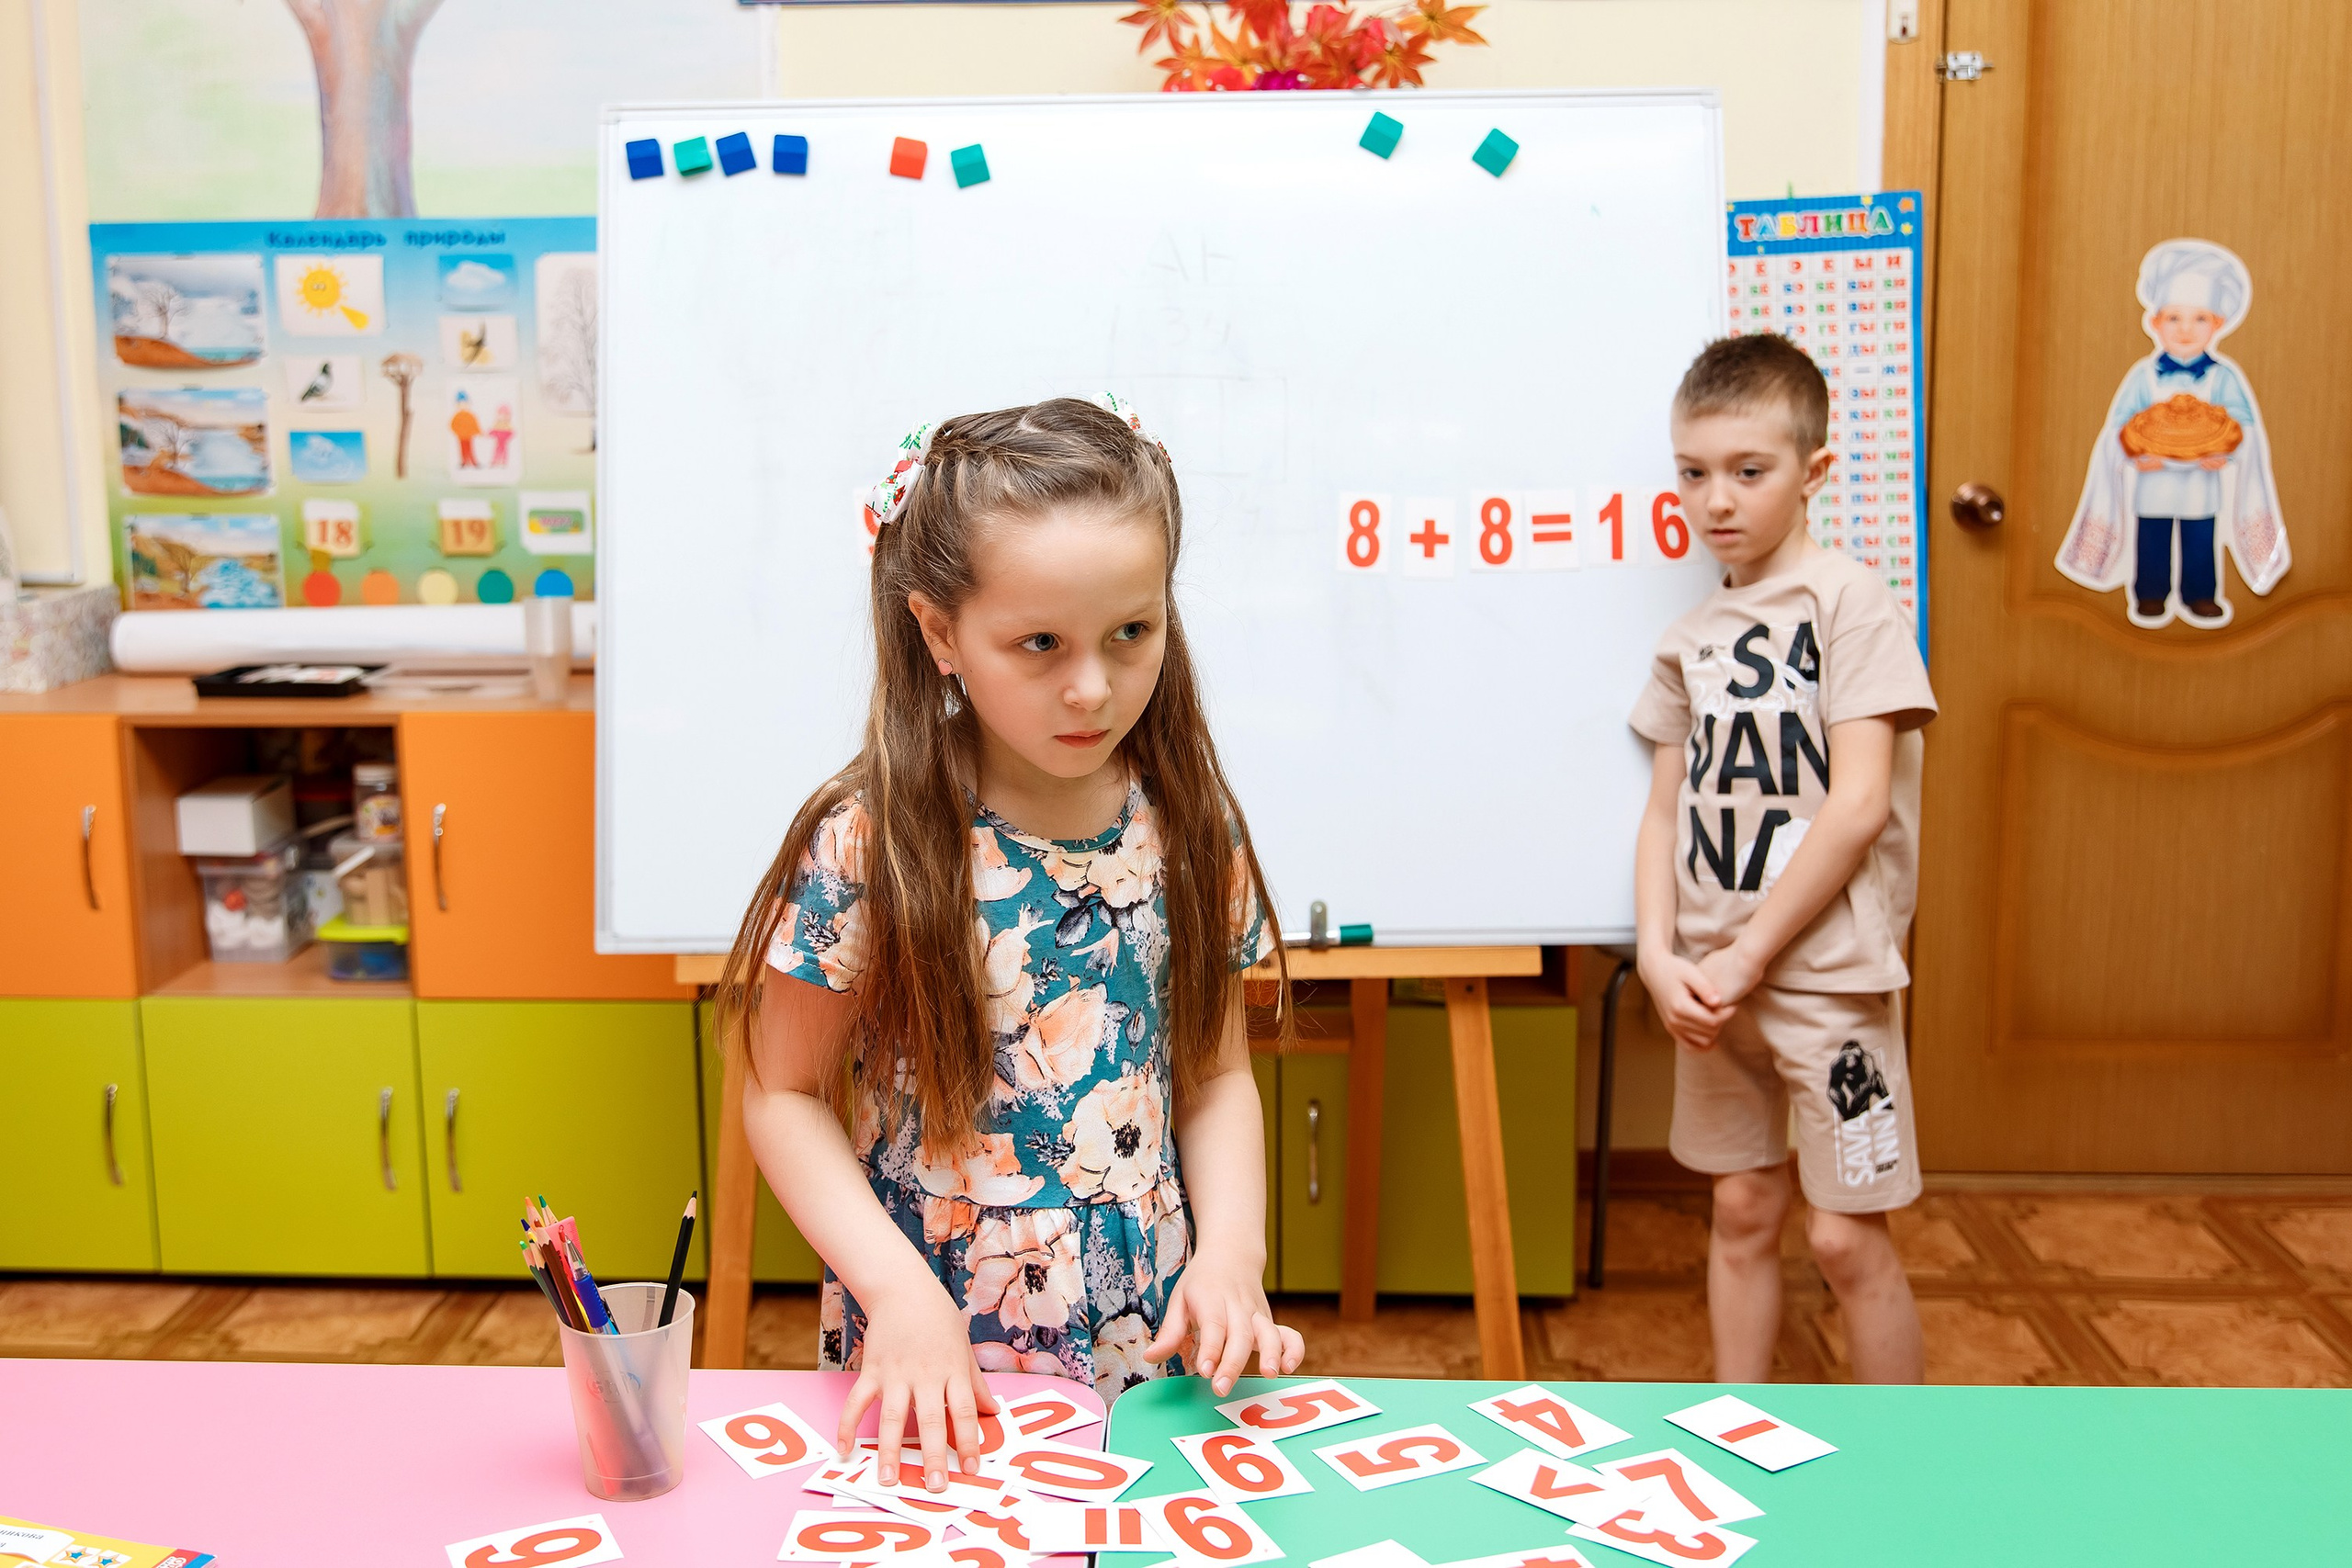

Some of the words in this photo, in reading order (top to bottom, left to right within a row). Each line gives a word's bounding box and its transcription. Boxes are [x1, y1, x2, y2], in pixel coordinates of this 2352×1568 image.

[1736, 210, 1895, 239] ТАБЛИЦА
[319, 519, 354, 548] 18
[453, 518, 488, 548] 19
[1346, 500, 1380, 568] 8
[1409, 519, 1449, 558] +
[1479, 498, 1513, 565] 8
[1532, 513, 1572, 542] =
[1726, 620, 1821, 699] SA
[1616, 1458, 1719, 1522] 7
